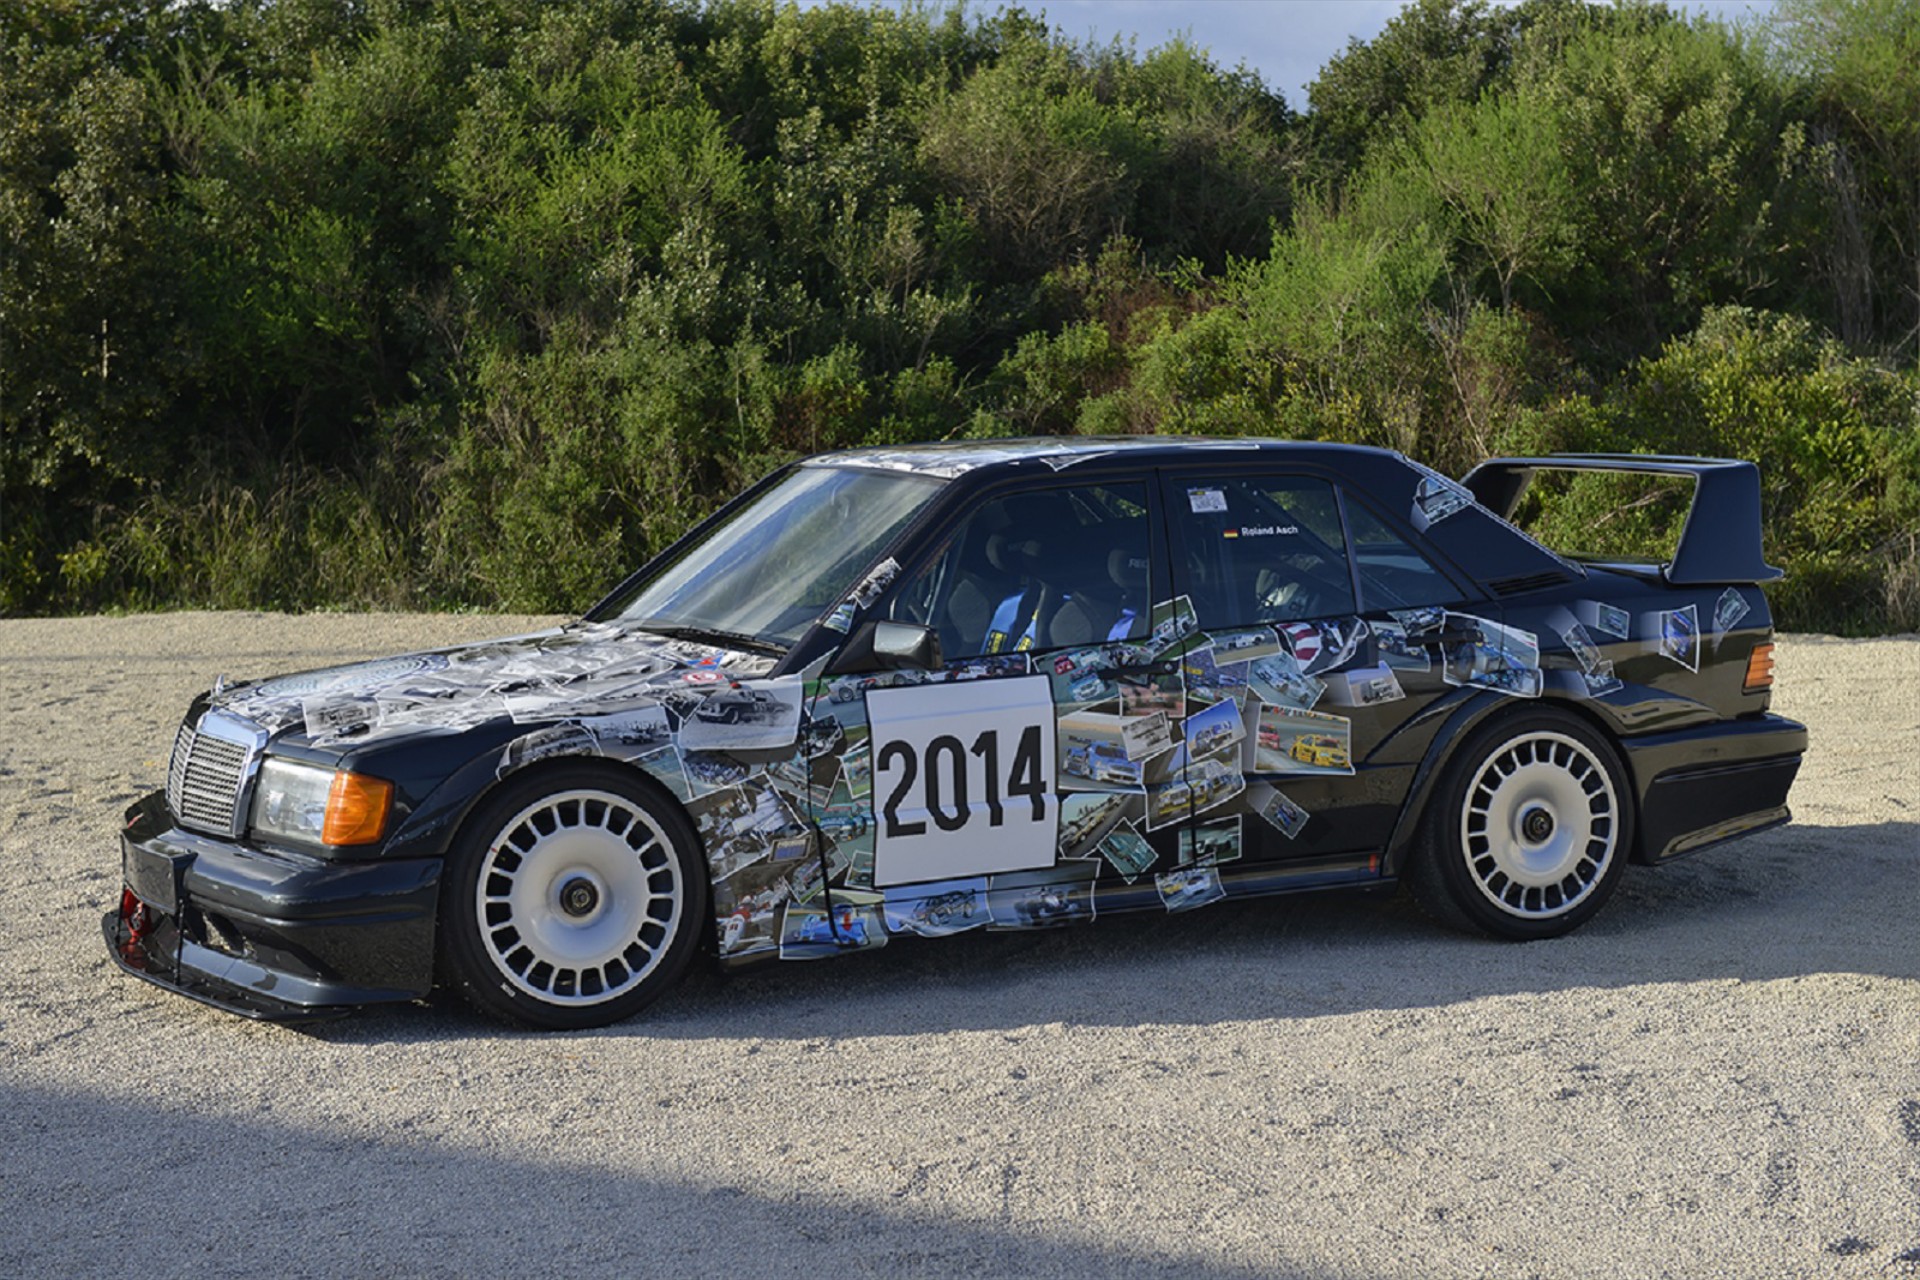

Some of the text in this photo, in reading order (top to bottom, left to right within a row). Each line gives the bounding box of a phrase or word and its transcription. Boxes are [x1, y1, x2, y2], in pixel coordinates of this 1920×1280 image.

[1241, 525, 1299, 536] Roland Asch
[877, 725, 1047, 838] 2014
